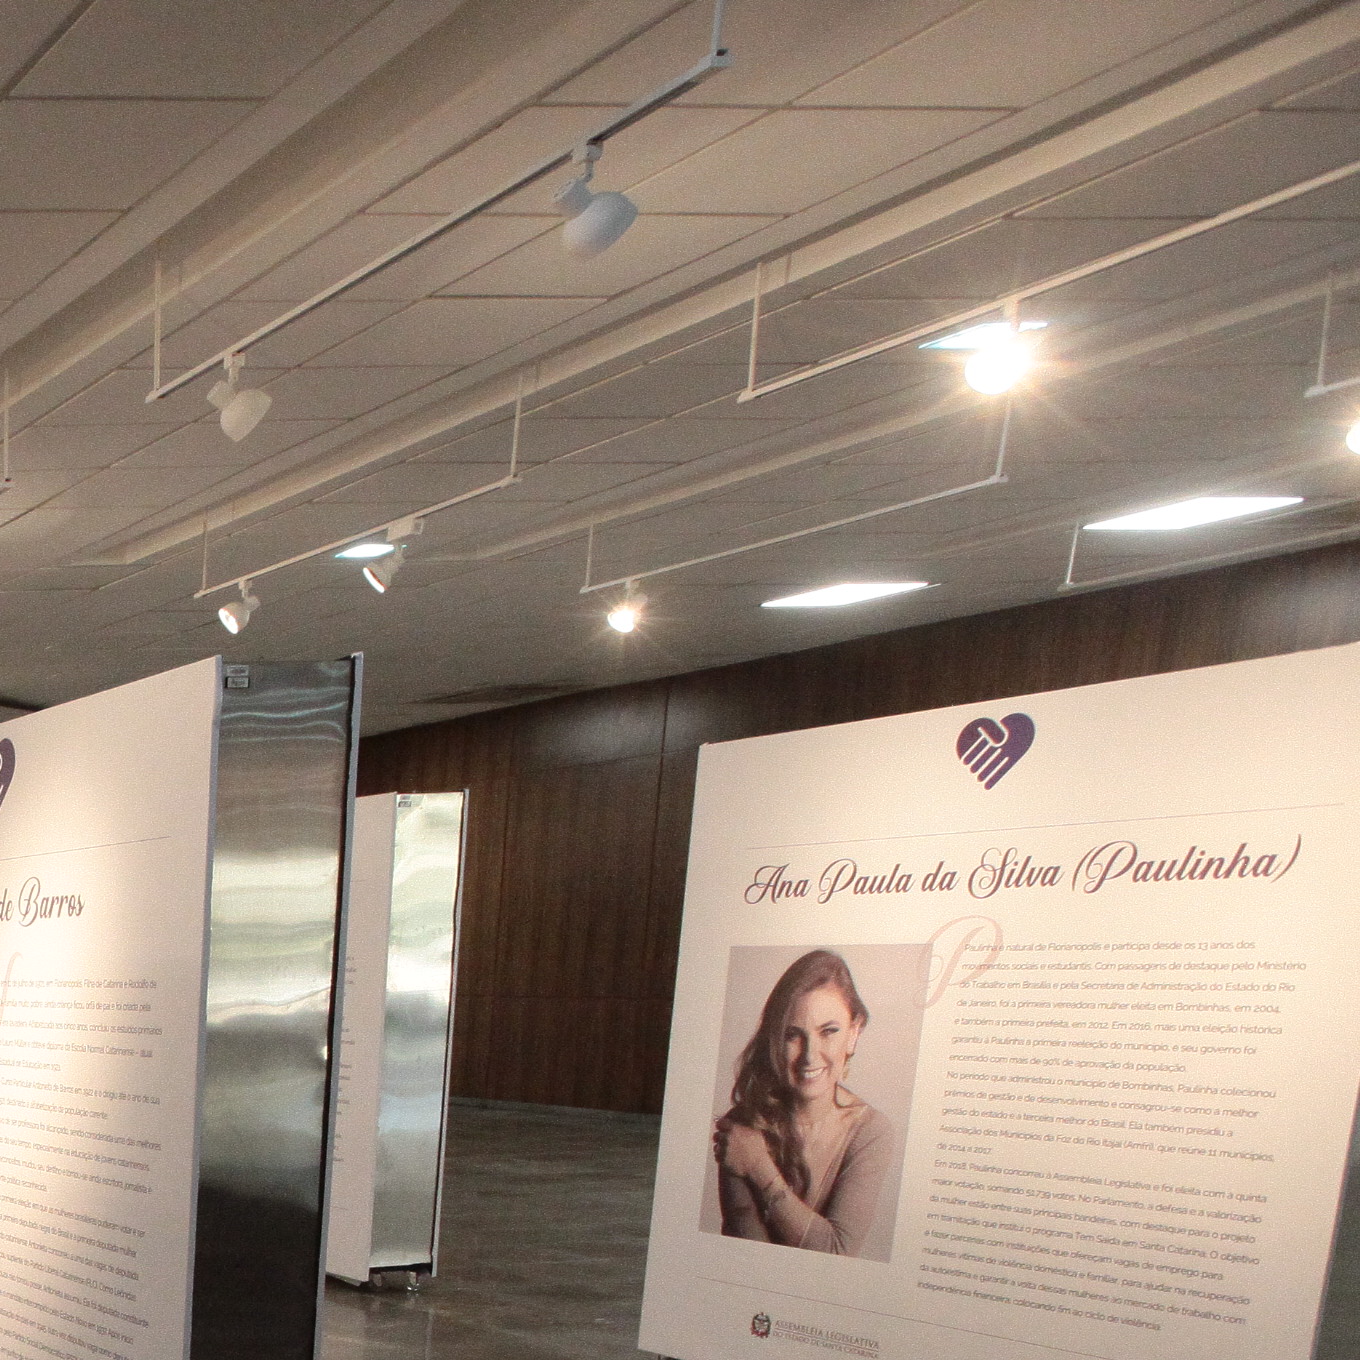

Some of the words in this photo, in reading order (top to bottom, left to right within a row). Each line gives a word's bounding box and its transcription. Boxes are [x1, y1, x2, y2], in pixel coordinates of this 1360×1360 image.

[744, 863, 811, 905] Ana
[817, 858, 915, 905] Paula
[922, 860, 960, 892] da
[968, 847, 1063, 900] Silva
[1071, 834, 1302, 896] (Paulinha)
[18, 876, 85, 927] Barros
[826, 1330, 879, 1349] LEGISLATIVA
